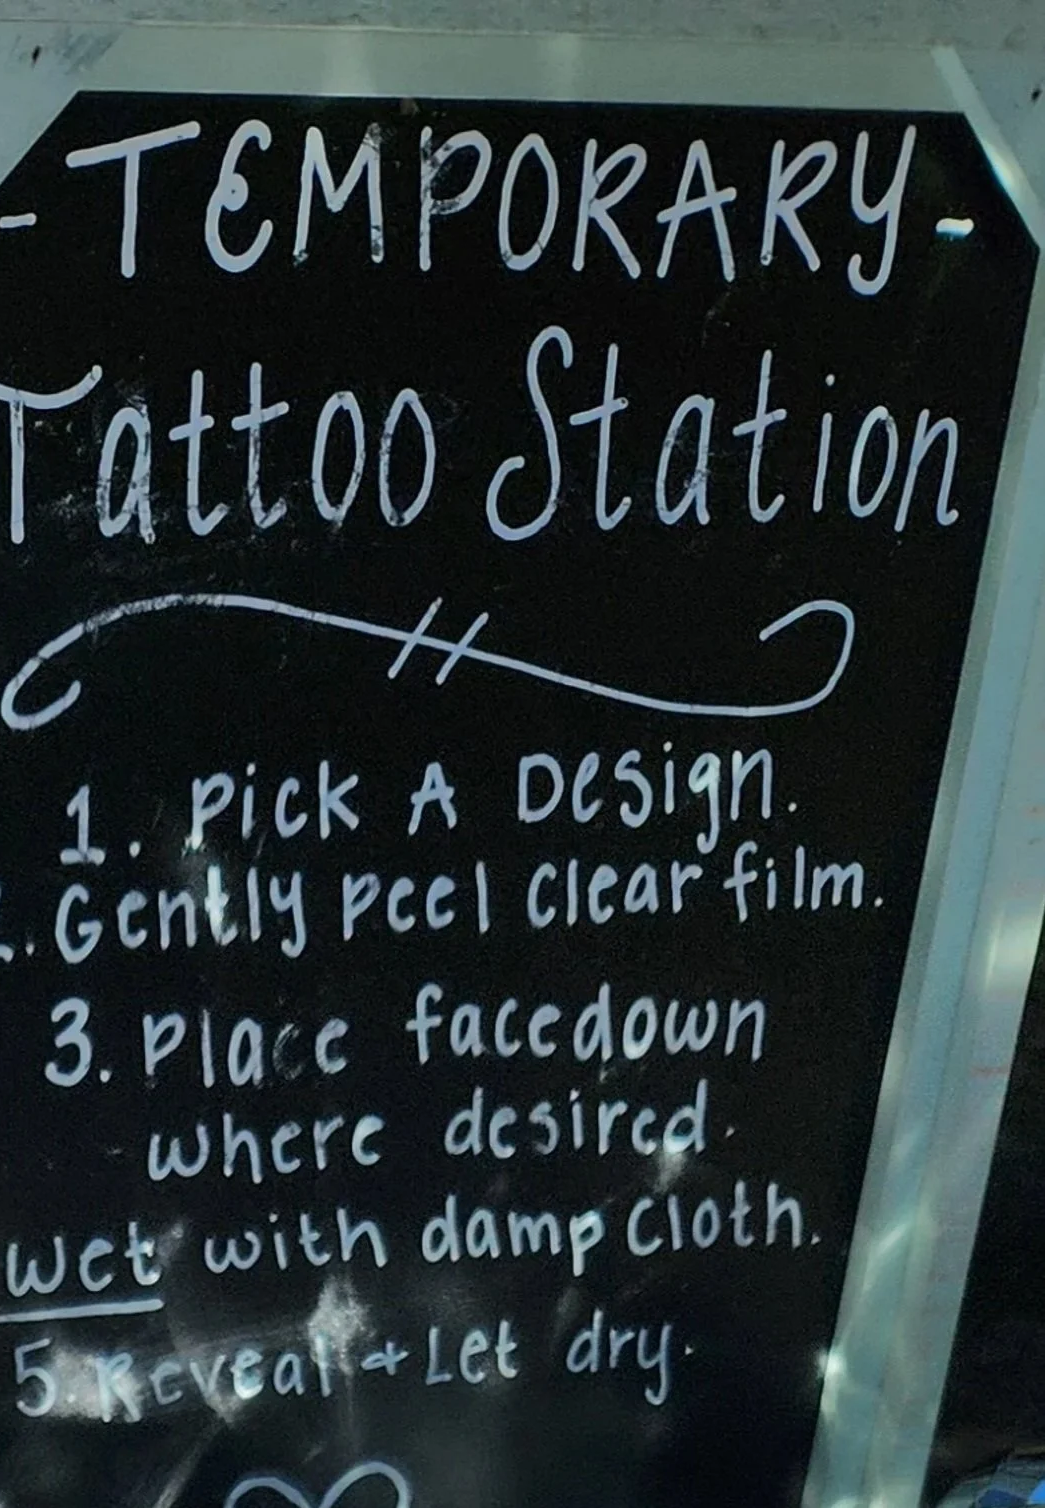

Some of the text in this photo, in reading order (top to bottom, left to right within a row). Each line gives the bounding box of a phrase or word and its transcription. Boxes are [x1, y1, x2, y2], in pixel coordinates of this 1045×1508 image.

[486, 325, 960, 541] Station
[60, 784, 141, 866] 1.
[407, 761, 457, 837] A
[517, 741, 797, 855] Design.
[724, 841, 884, 924] film.
[147, 1078, 736, 1186] where desired.
[204, 1207, 389, 1268] with
[421, 1194, 606, 1278] damp
[426, 1319, 518, 1385] Let
[565, 1308, 695, 1406] dry.
